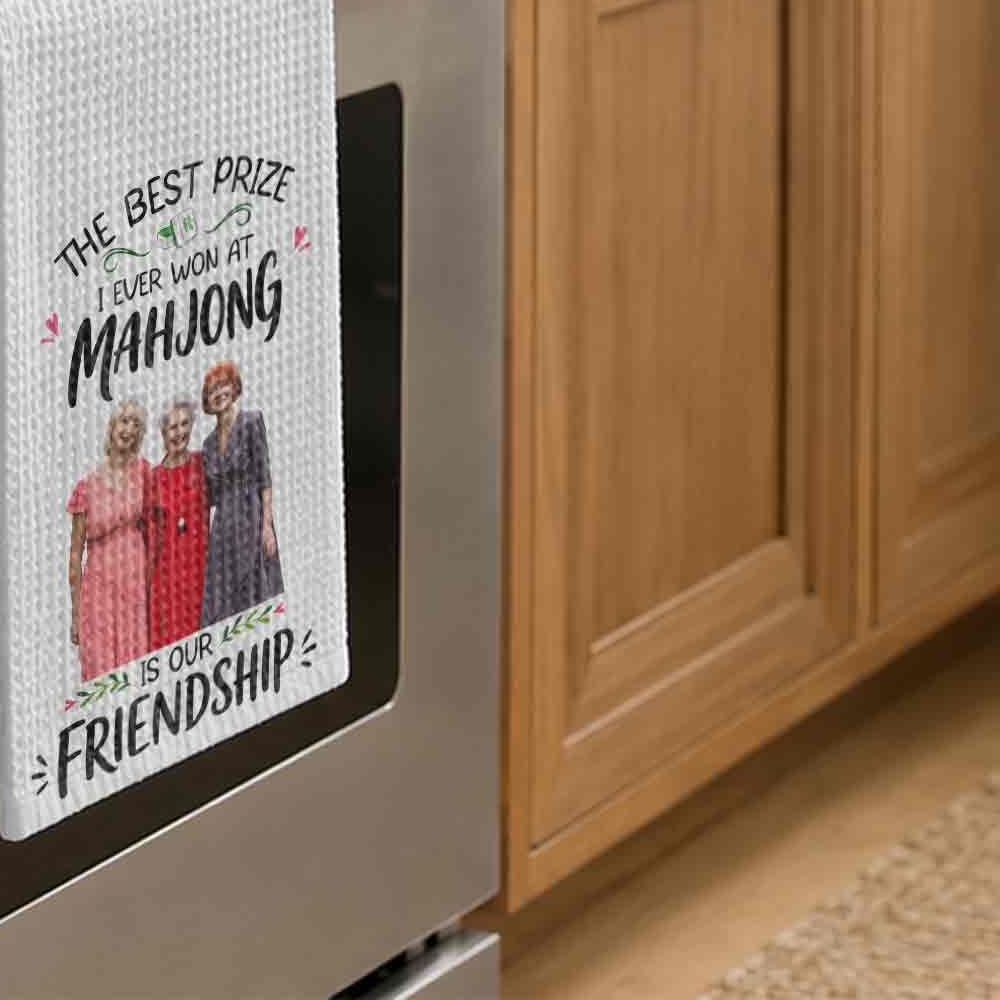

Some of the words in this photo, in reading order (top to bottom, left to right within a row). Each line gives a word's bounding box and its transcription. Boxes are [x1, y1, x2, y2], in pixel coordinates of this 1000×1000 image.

[54, 212, 117, 277] THE
[124, 161, 204, 228] BEST
[212, 155, 296, 203] PRIZE
[98, 287, 105, 313] I
[113, 268, 163, 306] EVER
[171, 248, 219, 285] WON
[228, 233, 255, 265] AT
[67, 249, 283, 409] MAHJONG
[57, 628, 295, 799] FRIENDSHIP
[140, 657, 160, 687] IS
[168, 632, 214, 673] OUR
